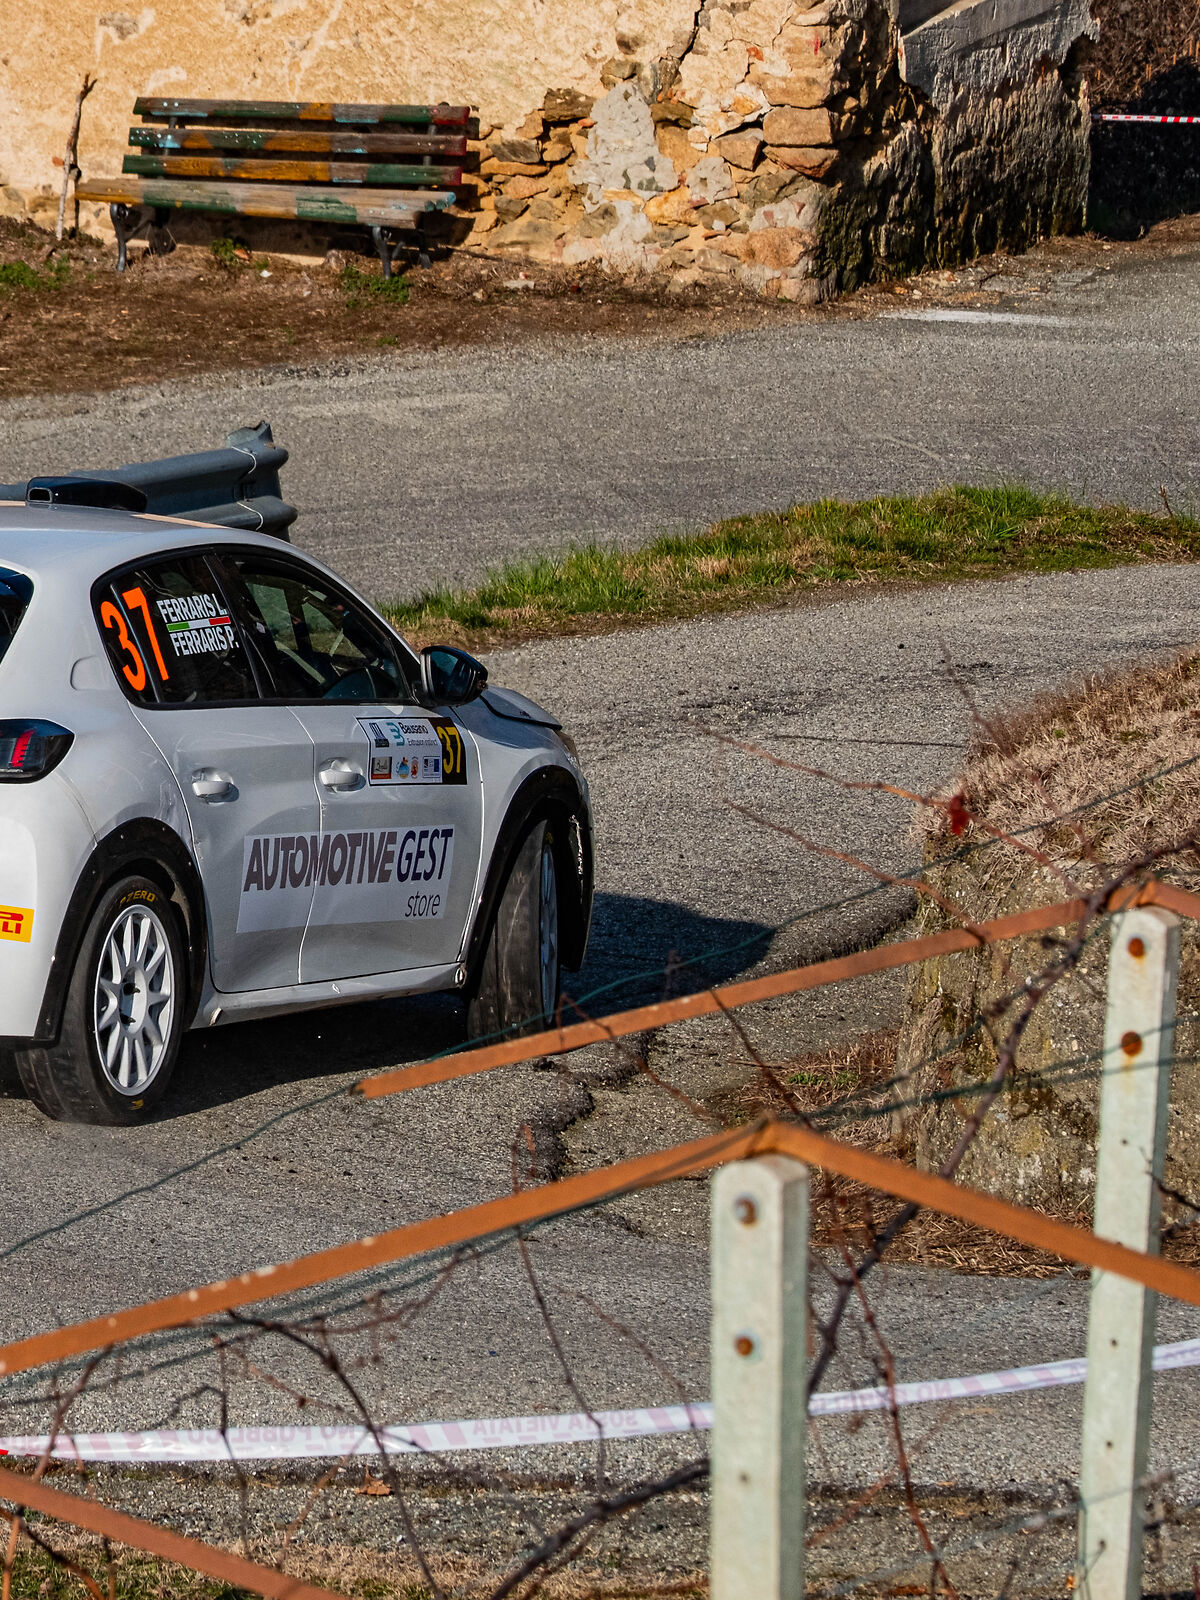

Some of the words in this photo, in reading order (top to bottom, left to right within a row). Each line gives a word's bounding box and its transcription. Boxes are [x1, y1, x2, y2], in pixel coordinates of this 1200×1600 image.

[156, 594, 217, 623] FERRARIS
[100, 586, 169, 692] 37
[169, 627, 228, 657] FERRARIS
[436, 726, 461, 774] 37
[404, 890, 441, 918] store
